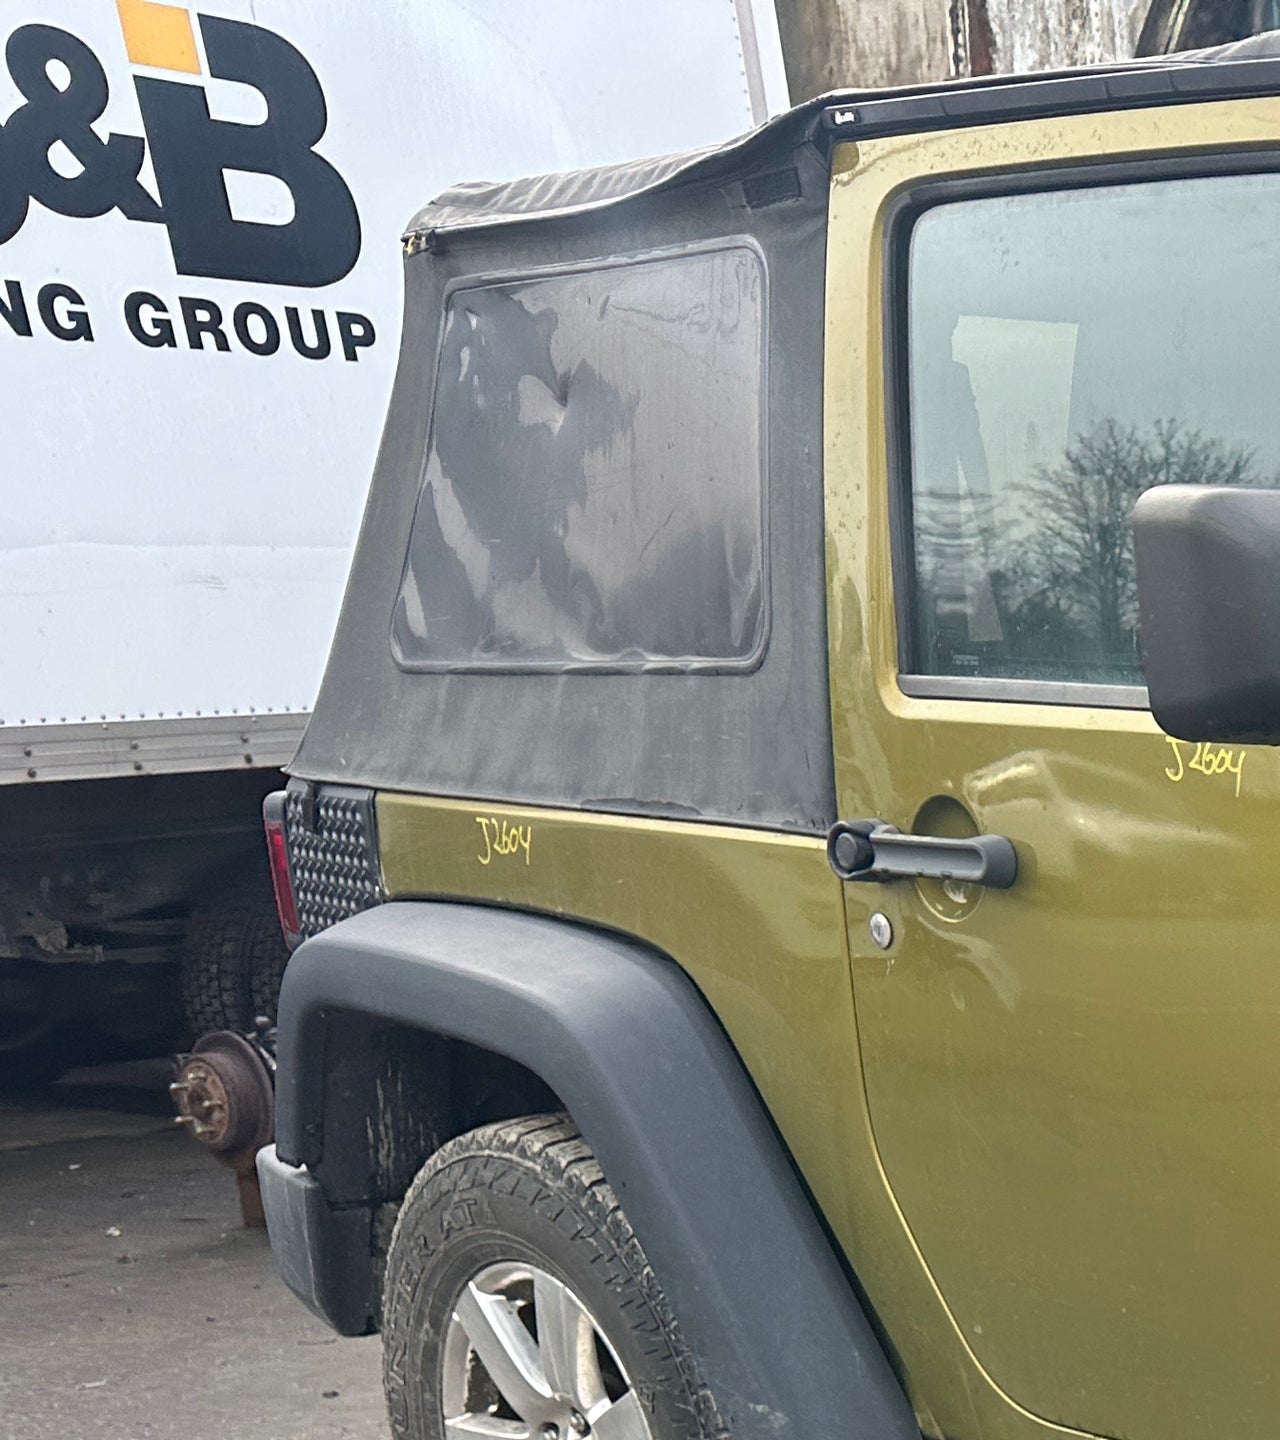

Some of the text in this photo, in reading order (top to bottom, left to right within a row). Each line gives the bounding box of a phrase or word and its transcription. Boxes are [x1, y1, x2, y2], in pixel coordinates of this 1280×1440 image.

[0, 0, 362, 288] &B
[124, 290, 377, 362] GROUP
[475, 817, 532, 866] J2604
